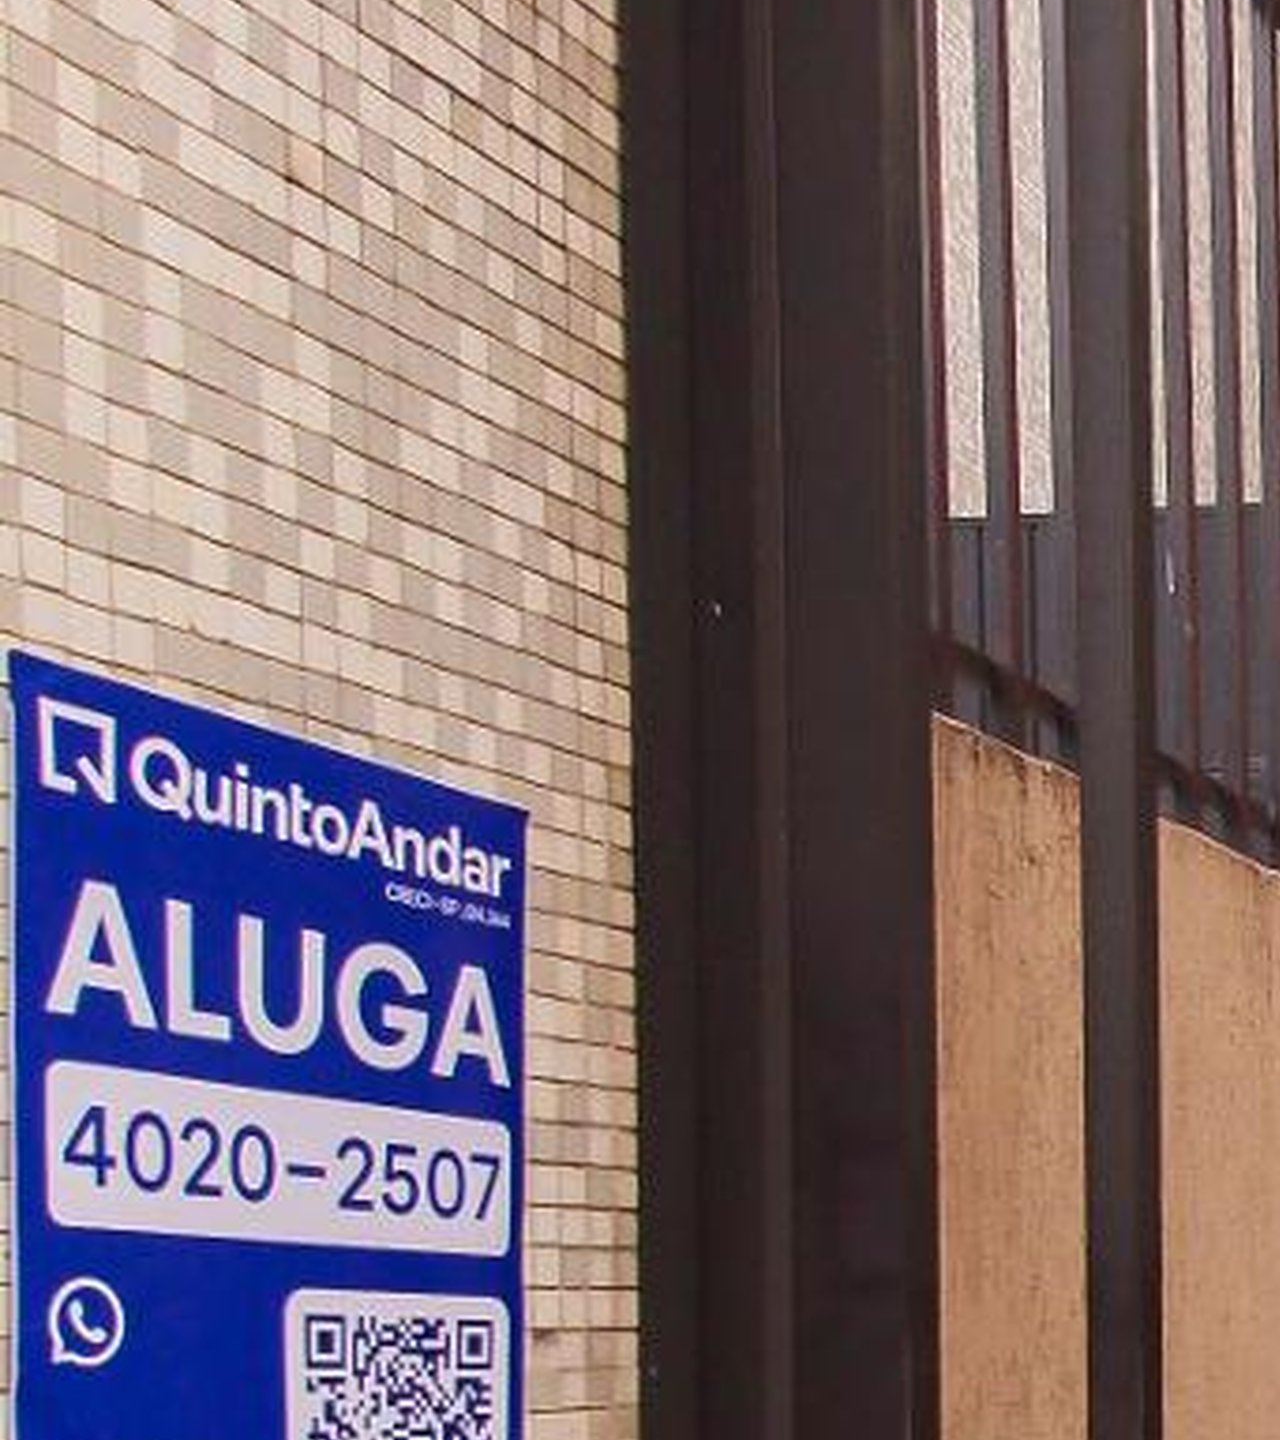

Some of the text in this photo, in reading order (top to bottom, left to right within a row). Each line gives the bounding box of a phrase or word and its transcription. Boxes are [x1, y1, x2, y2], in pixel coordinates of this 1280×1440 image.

[129, 733, 511, 897] QuintoAndar
[45, 880, 512, 1089] ALUGA
[63, 1104, 502, 1222] 4020-2507
